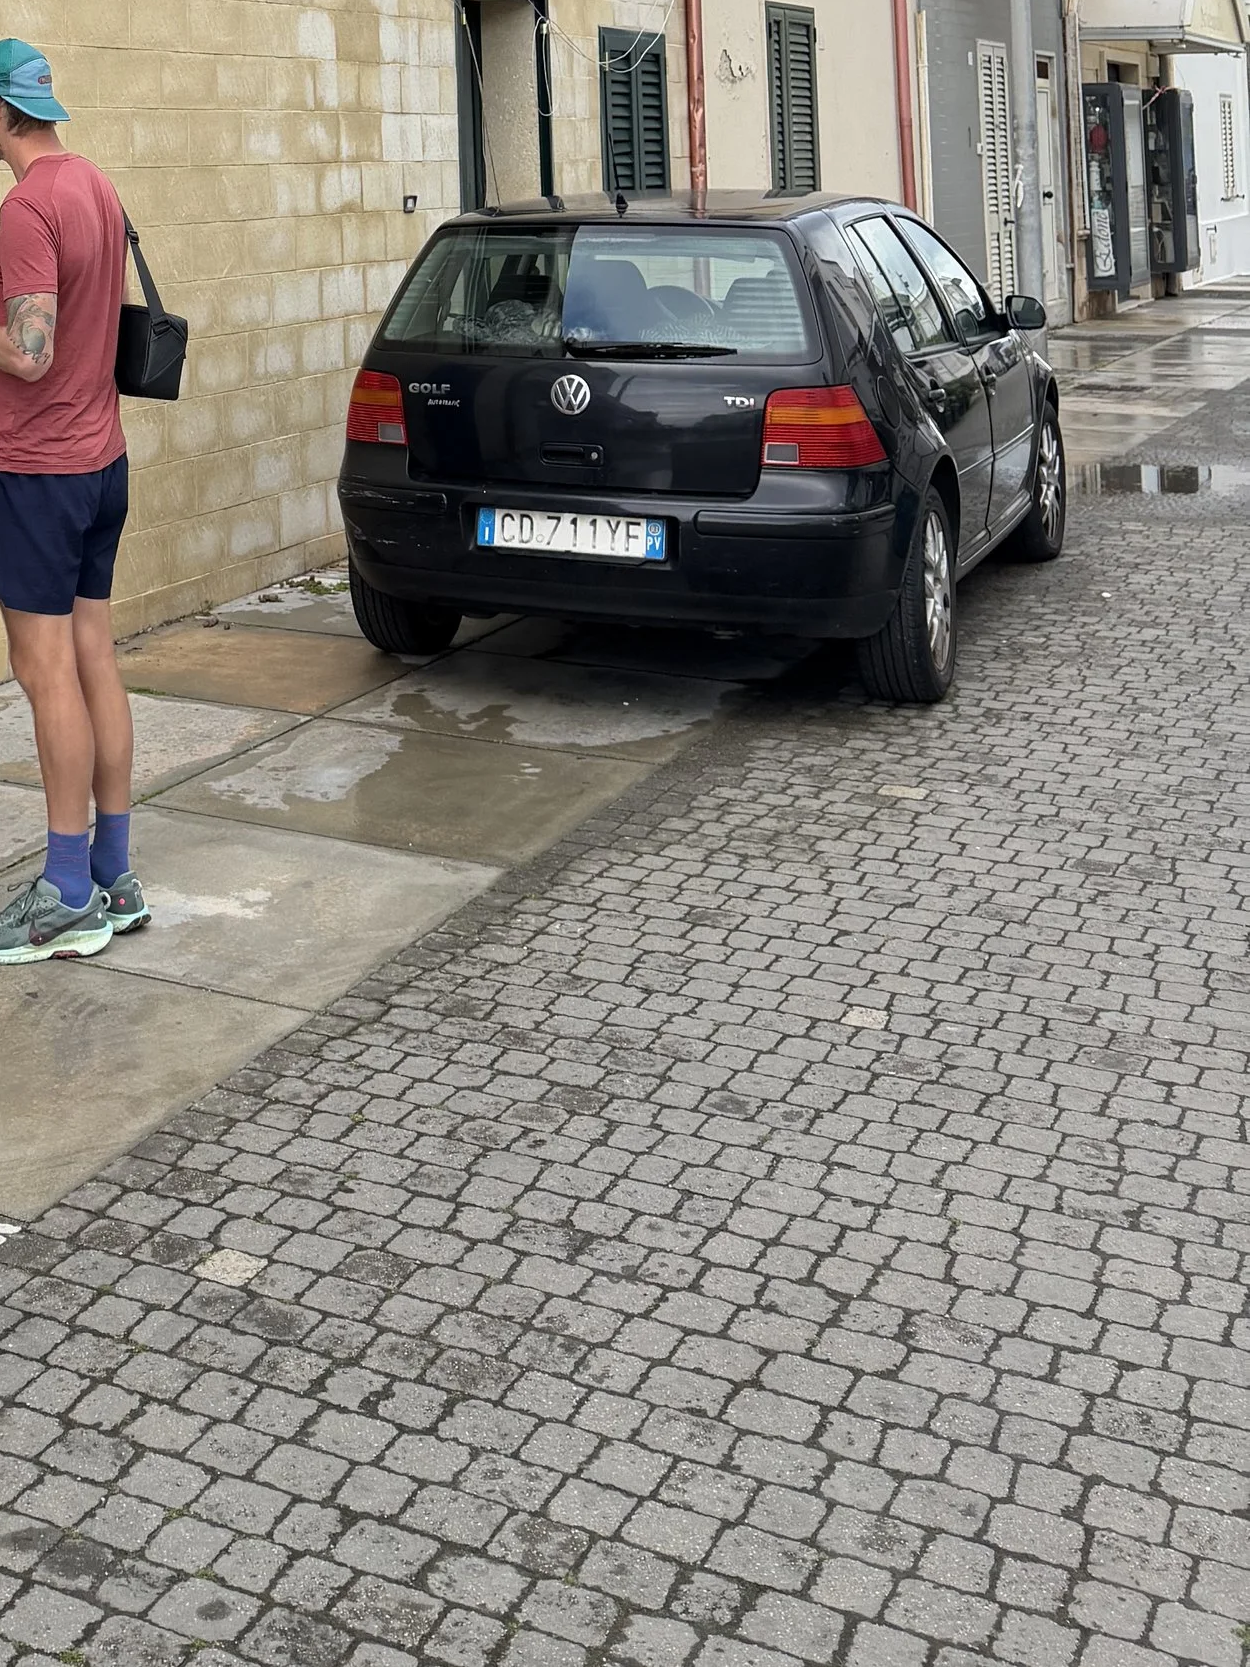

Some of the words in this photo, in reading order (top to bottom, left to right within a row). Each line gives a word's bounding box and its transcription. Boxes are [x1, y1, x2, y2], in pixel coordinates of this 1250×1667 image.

[408, 382, 451, 394] GOLF
[723, 396, 755, 408] TDI
[484, 526, 490, 541] I
[647, 536, 661, 551] PV
